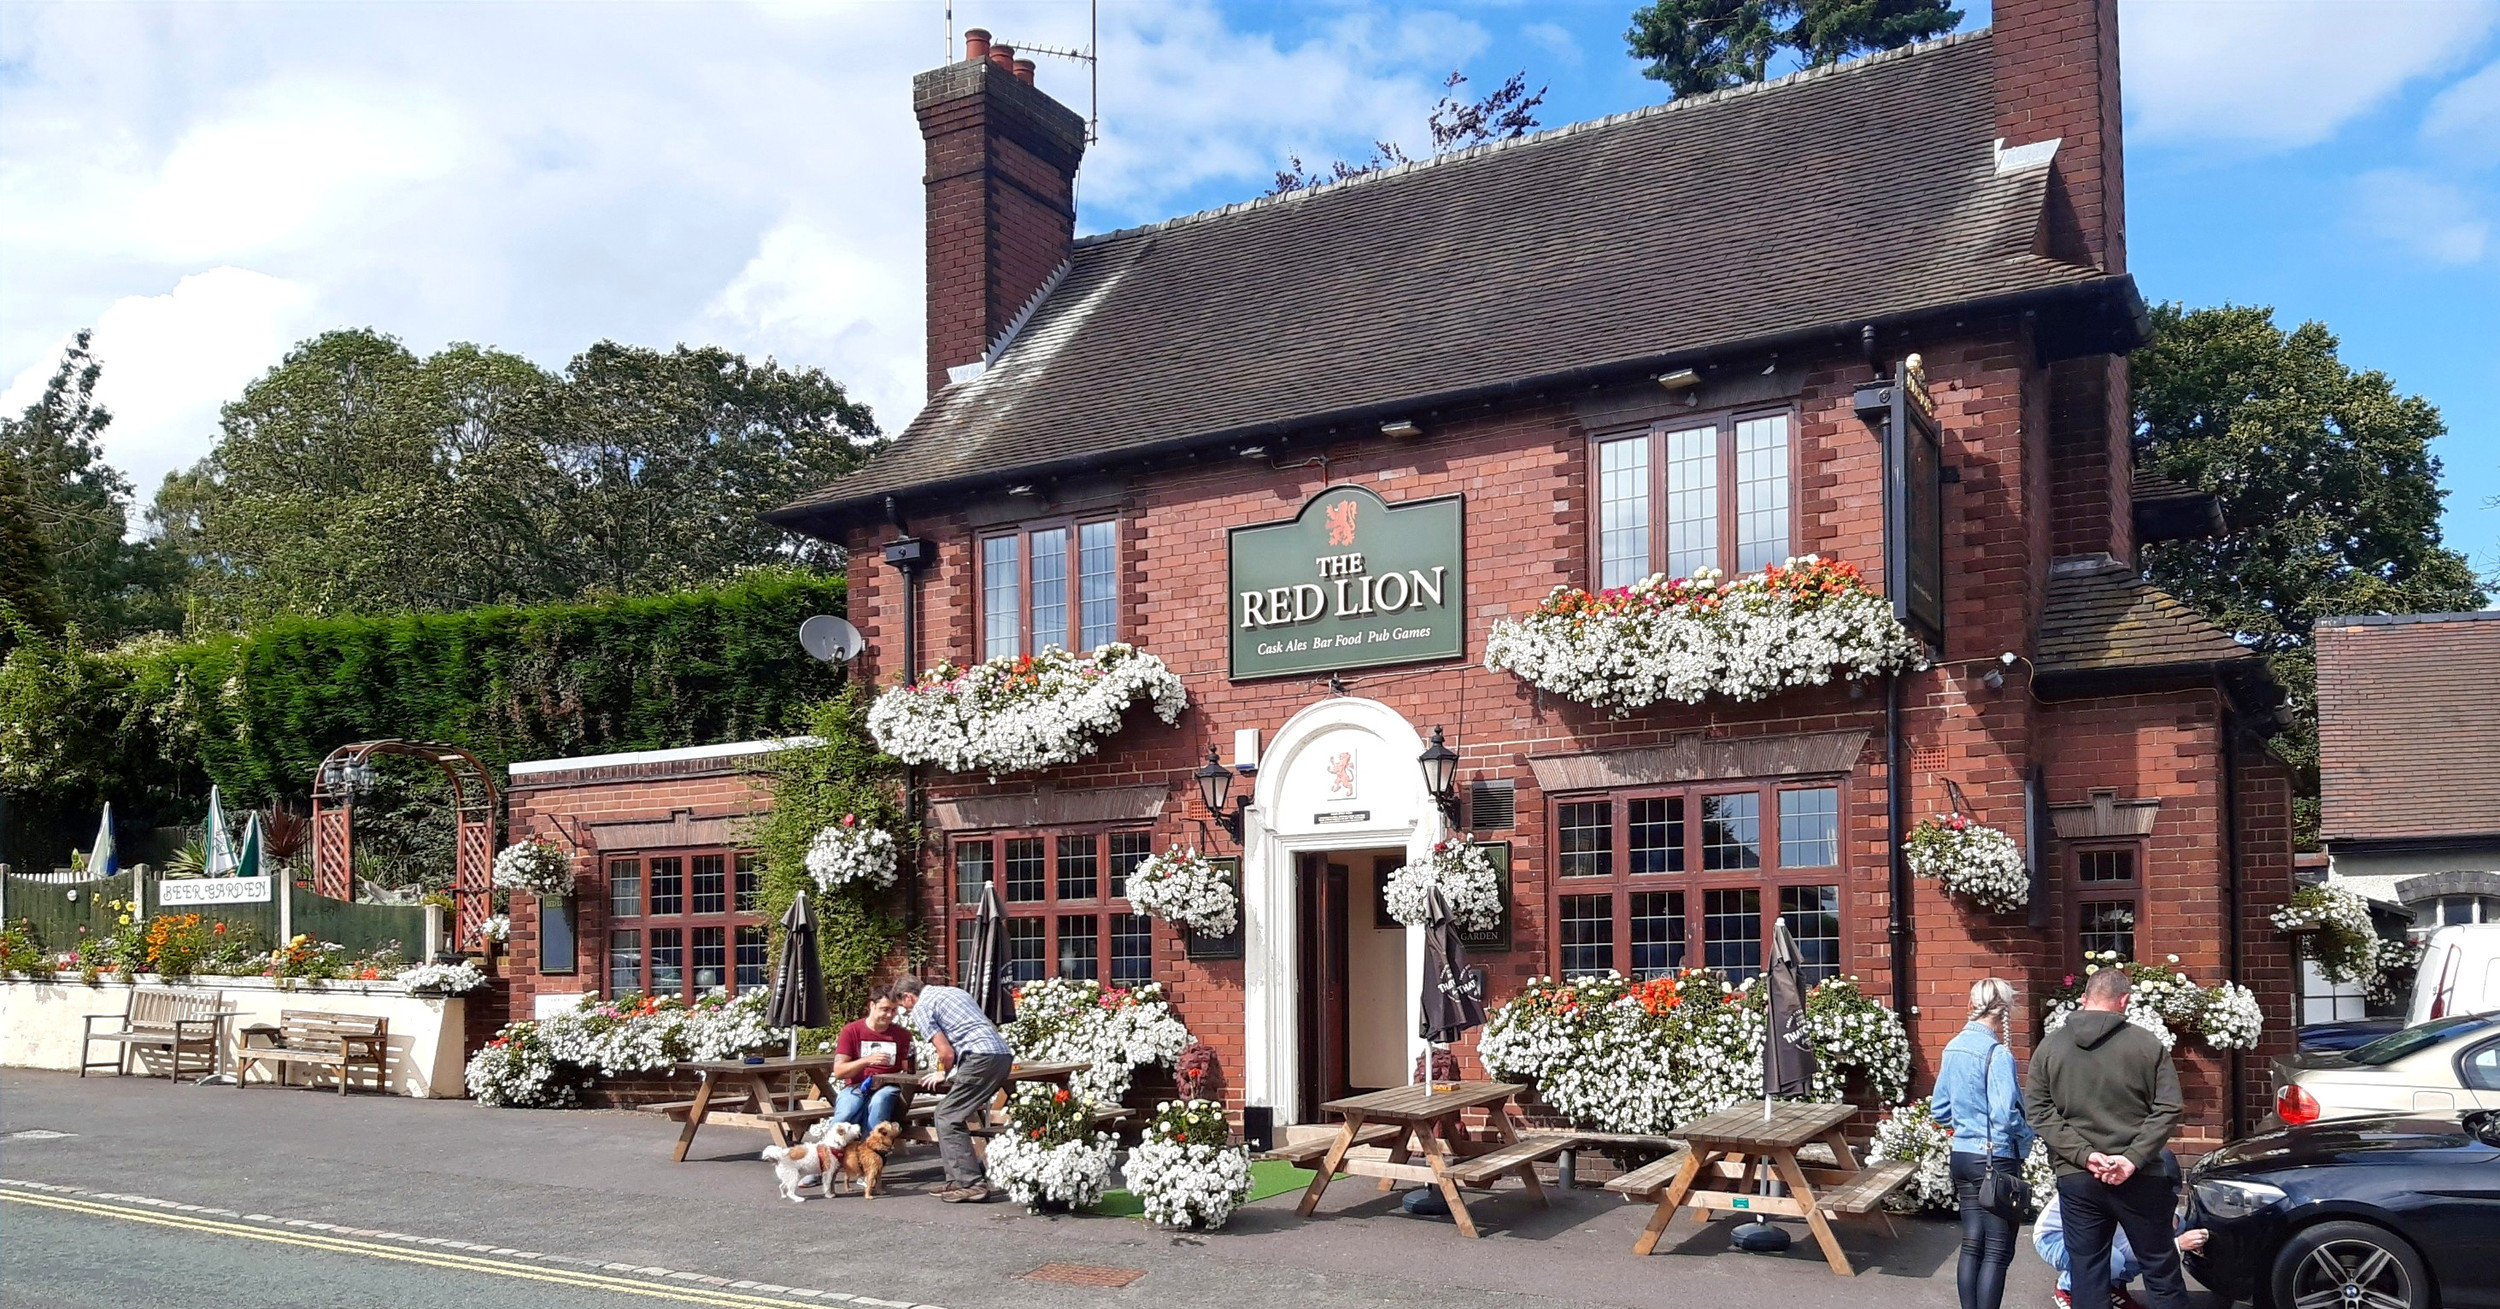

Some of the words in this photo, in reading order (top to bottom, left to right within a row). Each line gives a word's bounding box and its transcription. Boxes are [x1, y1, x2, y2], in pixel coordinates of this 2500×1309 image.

[1316, 552, 1364, 577] THE
[1239, 582, 1327, 628] RED
[1333, 566, 1446, 617] LION
[1257, 638, 1283, 656] Cask
[1285, 638, 1308, 653] Ales
[1312, 635, 1333, 650] Bar
[1335, 632, 1362, 647] Food
[1367, 628, 1390, 644] Pub
[1392, 626, 1431, 641] Games
[163, 885, 205, 901] BEER
[204, 881, 267, 899] GARDEN
[1460, 931, 1499, 941] GARDEN
